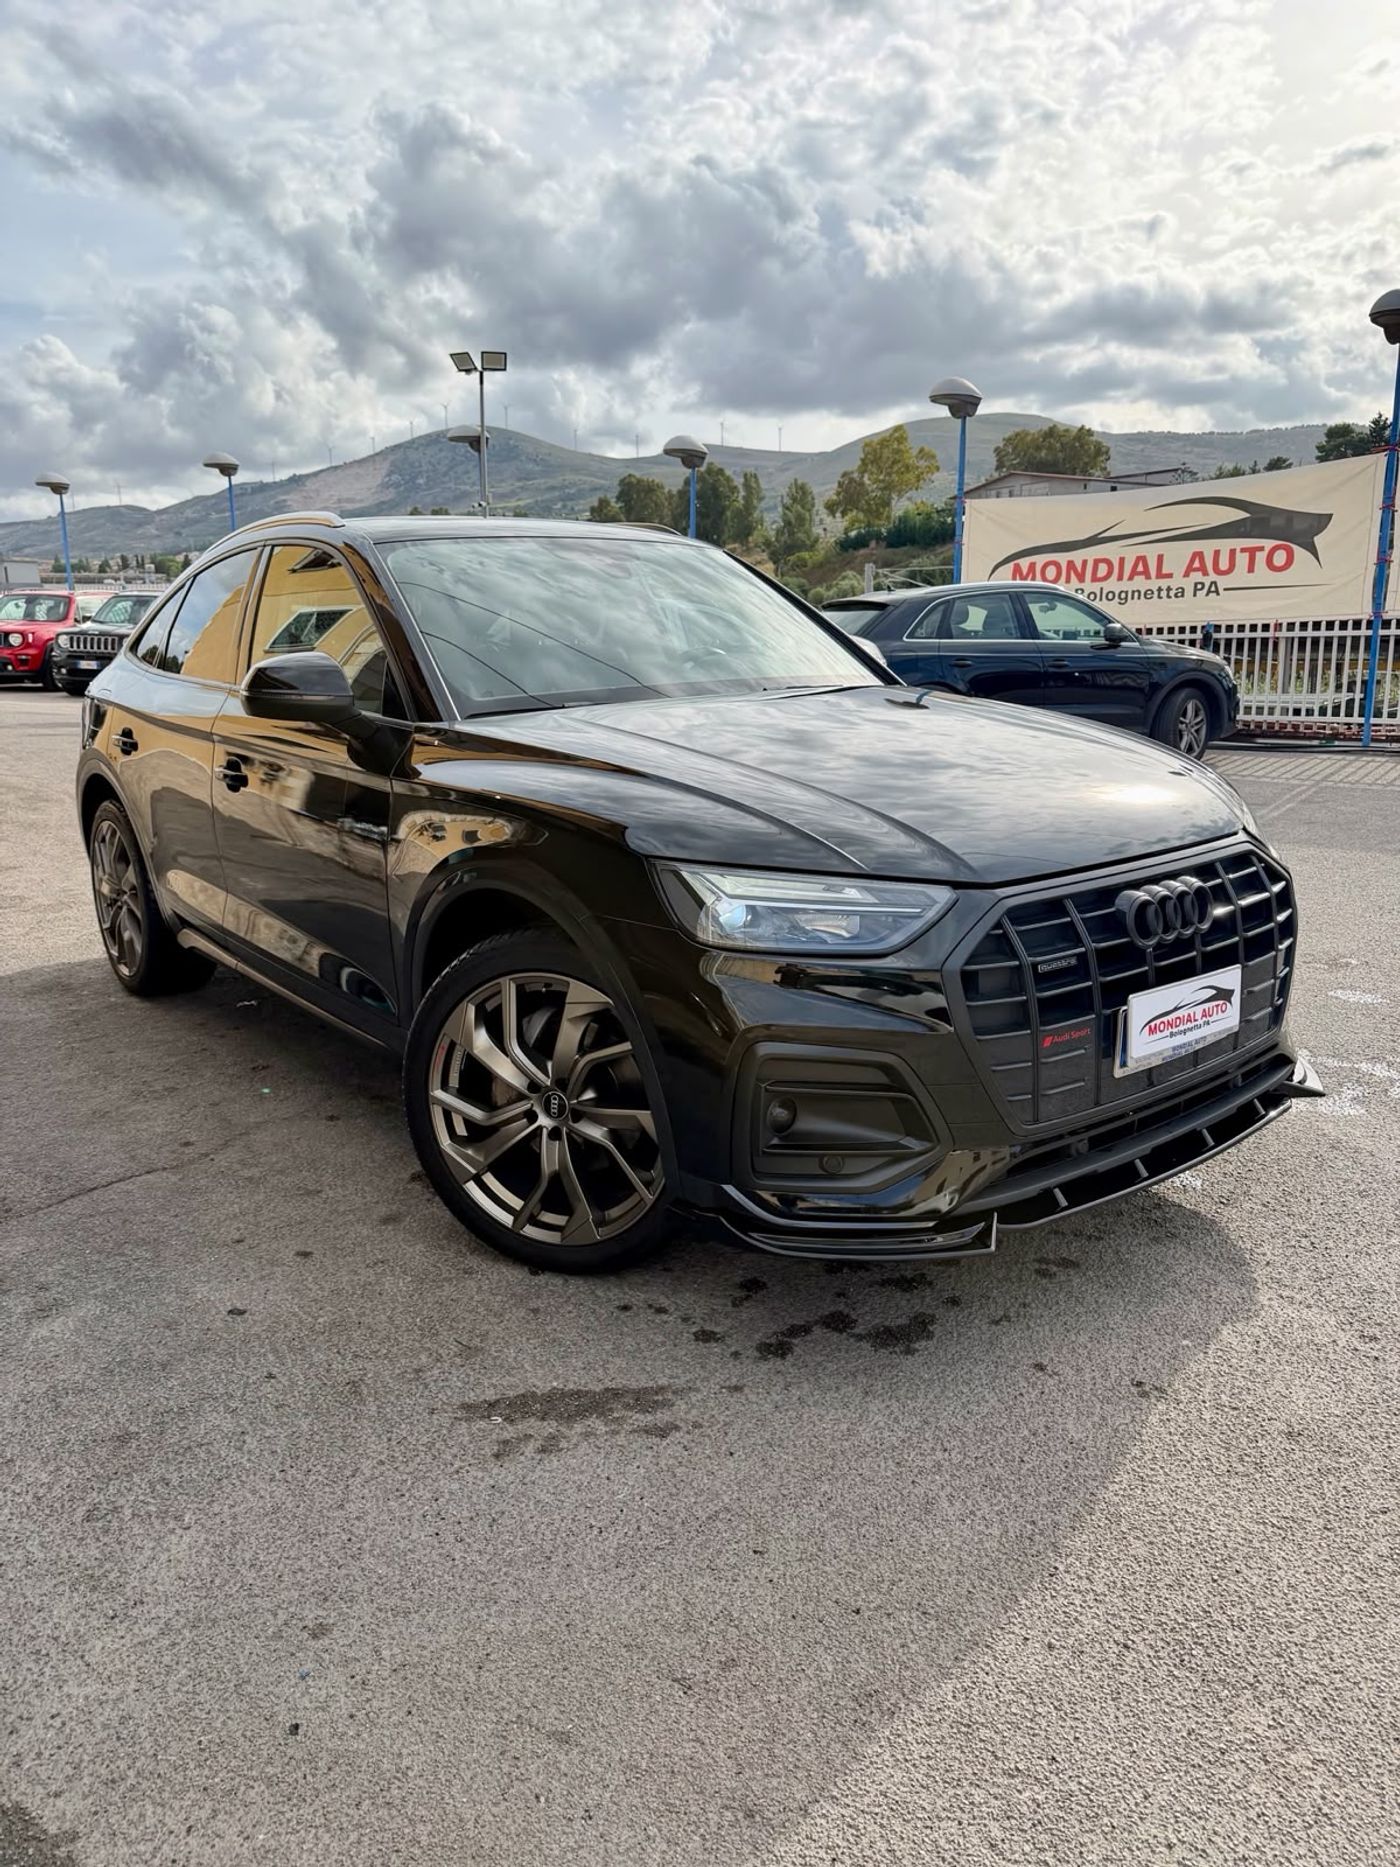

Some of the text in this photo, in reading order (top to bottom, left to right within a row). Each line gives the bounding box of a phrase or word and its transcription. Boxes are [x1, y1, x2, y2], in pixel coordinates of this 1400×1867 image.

[1011, 543, 1295, 585] MONDIAL AUTO
[1193, 581, 1221, 597] PA
[1147, 1002, 1228, 1036] MONDIAL AUTO
[1053, 1028, 1091, 1043] Audi Sport
[1169, 1023, 1202, 1038] Bolognetta
